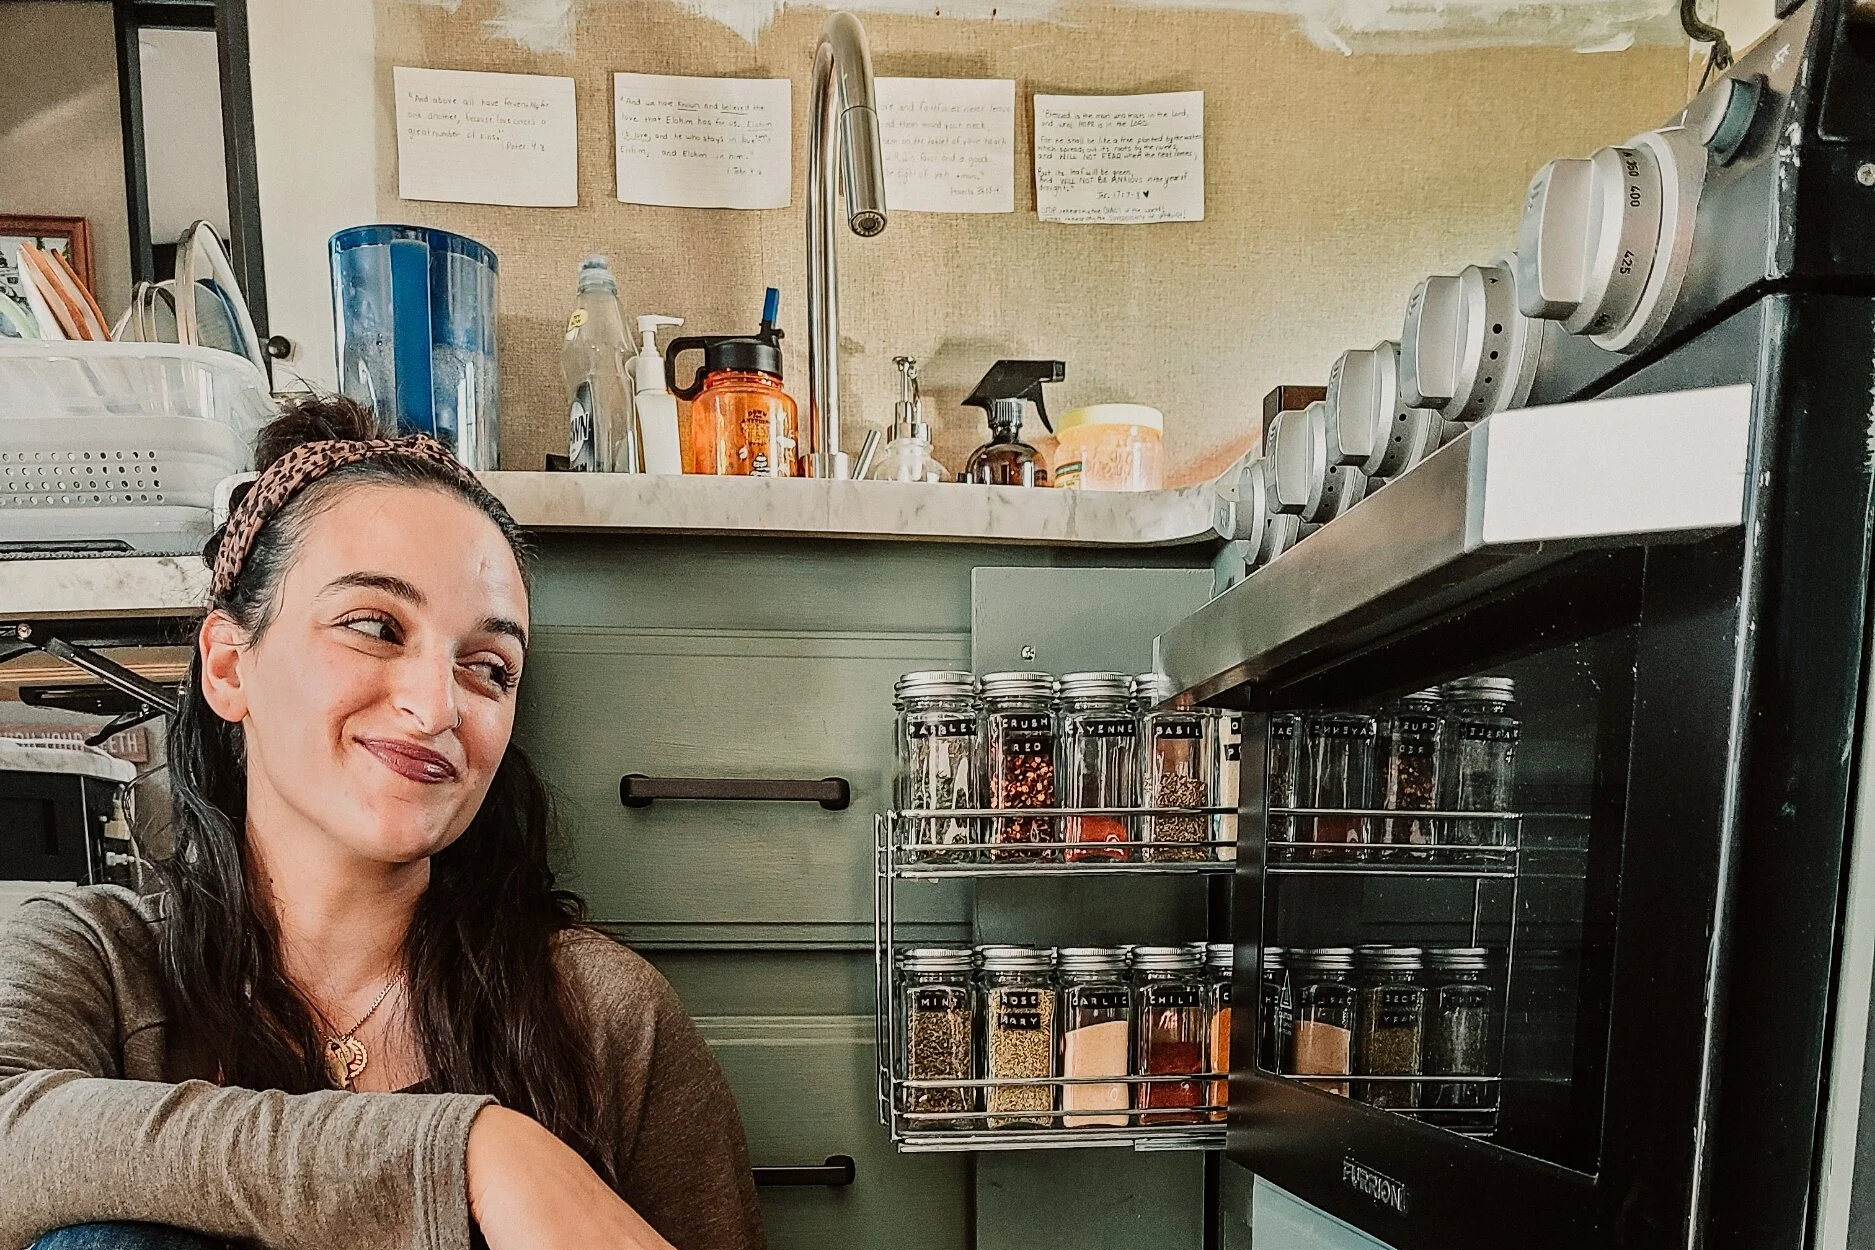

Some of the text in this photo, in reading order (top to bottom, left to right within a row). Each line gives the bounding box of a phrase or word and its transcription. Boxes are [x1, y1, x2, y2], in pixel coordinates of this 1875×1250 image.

[482, 98, 499, 107] have
[900, 102, 914, 112] and
[621, 112, 639, 123] love
[666, 115, 693, 125] Elohim
[697, 117, 712, 126] has
[408, 128, 430, 140] great
[432, 130, 460, 138] number
[1137, 134, 1164, 145] planted
[661, 149, 677, 157] and
[682, 150, 708, 159] Elohim
[941, 152, 955, 162] and
[1059, 152, 1077, 160] WILL
[1083, 152, 1097, 160] NOT
[1070, 167, 1085, 175] leaf
[1627, 160, 1640, 177] 350
[1097, 175, 1108, 184] BE
[1111, 175, 1143, 184] ANXIOUS
[1164, 175, 1184, 189] year
[1630, 185, 1641, 207] 400
[1620, 250, 1635, 275] 425
[1002, 717, 1049, 730] CRUSH
[908, 723, 977, 736] PARSLEY
[1067, 724, 1134, 736] CAYENNE
[1156, 726, 1200, 736] BASIL
[1012, 742, 1042, 752] RED
[921, 997, 959, 1008] MINT
[1001, 994, 1037, 1005] ROSE
[1072, 996, 1128, 1006] GARLIC
[1150, 995, 1193, 1005] CHILI
[1001, 1015, 1038, 1026] MARY
[1342, 1159, 1403, 1212] FURRION
